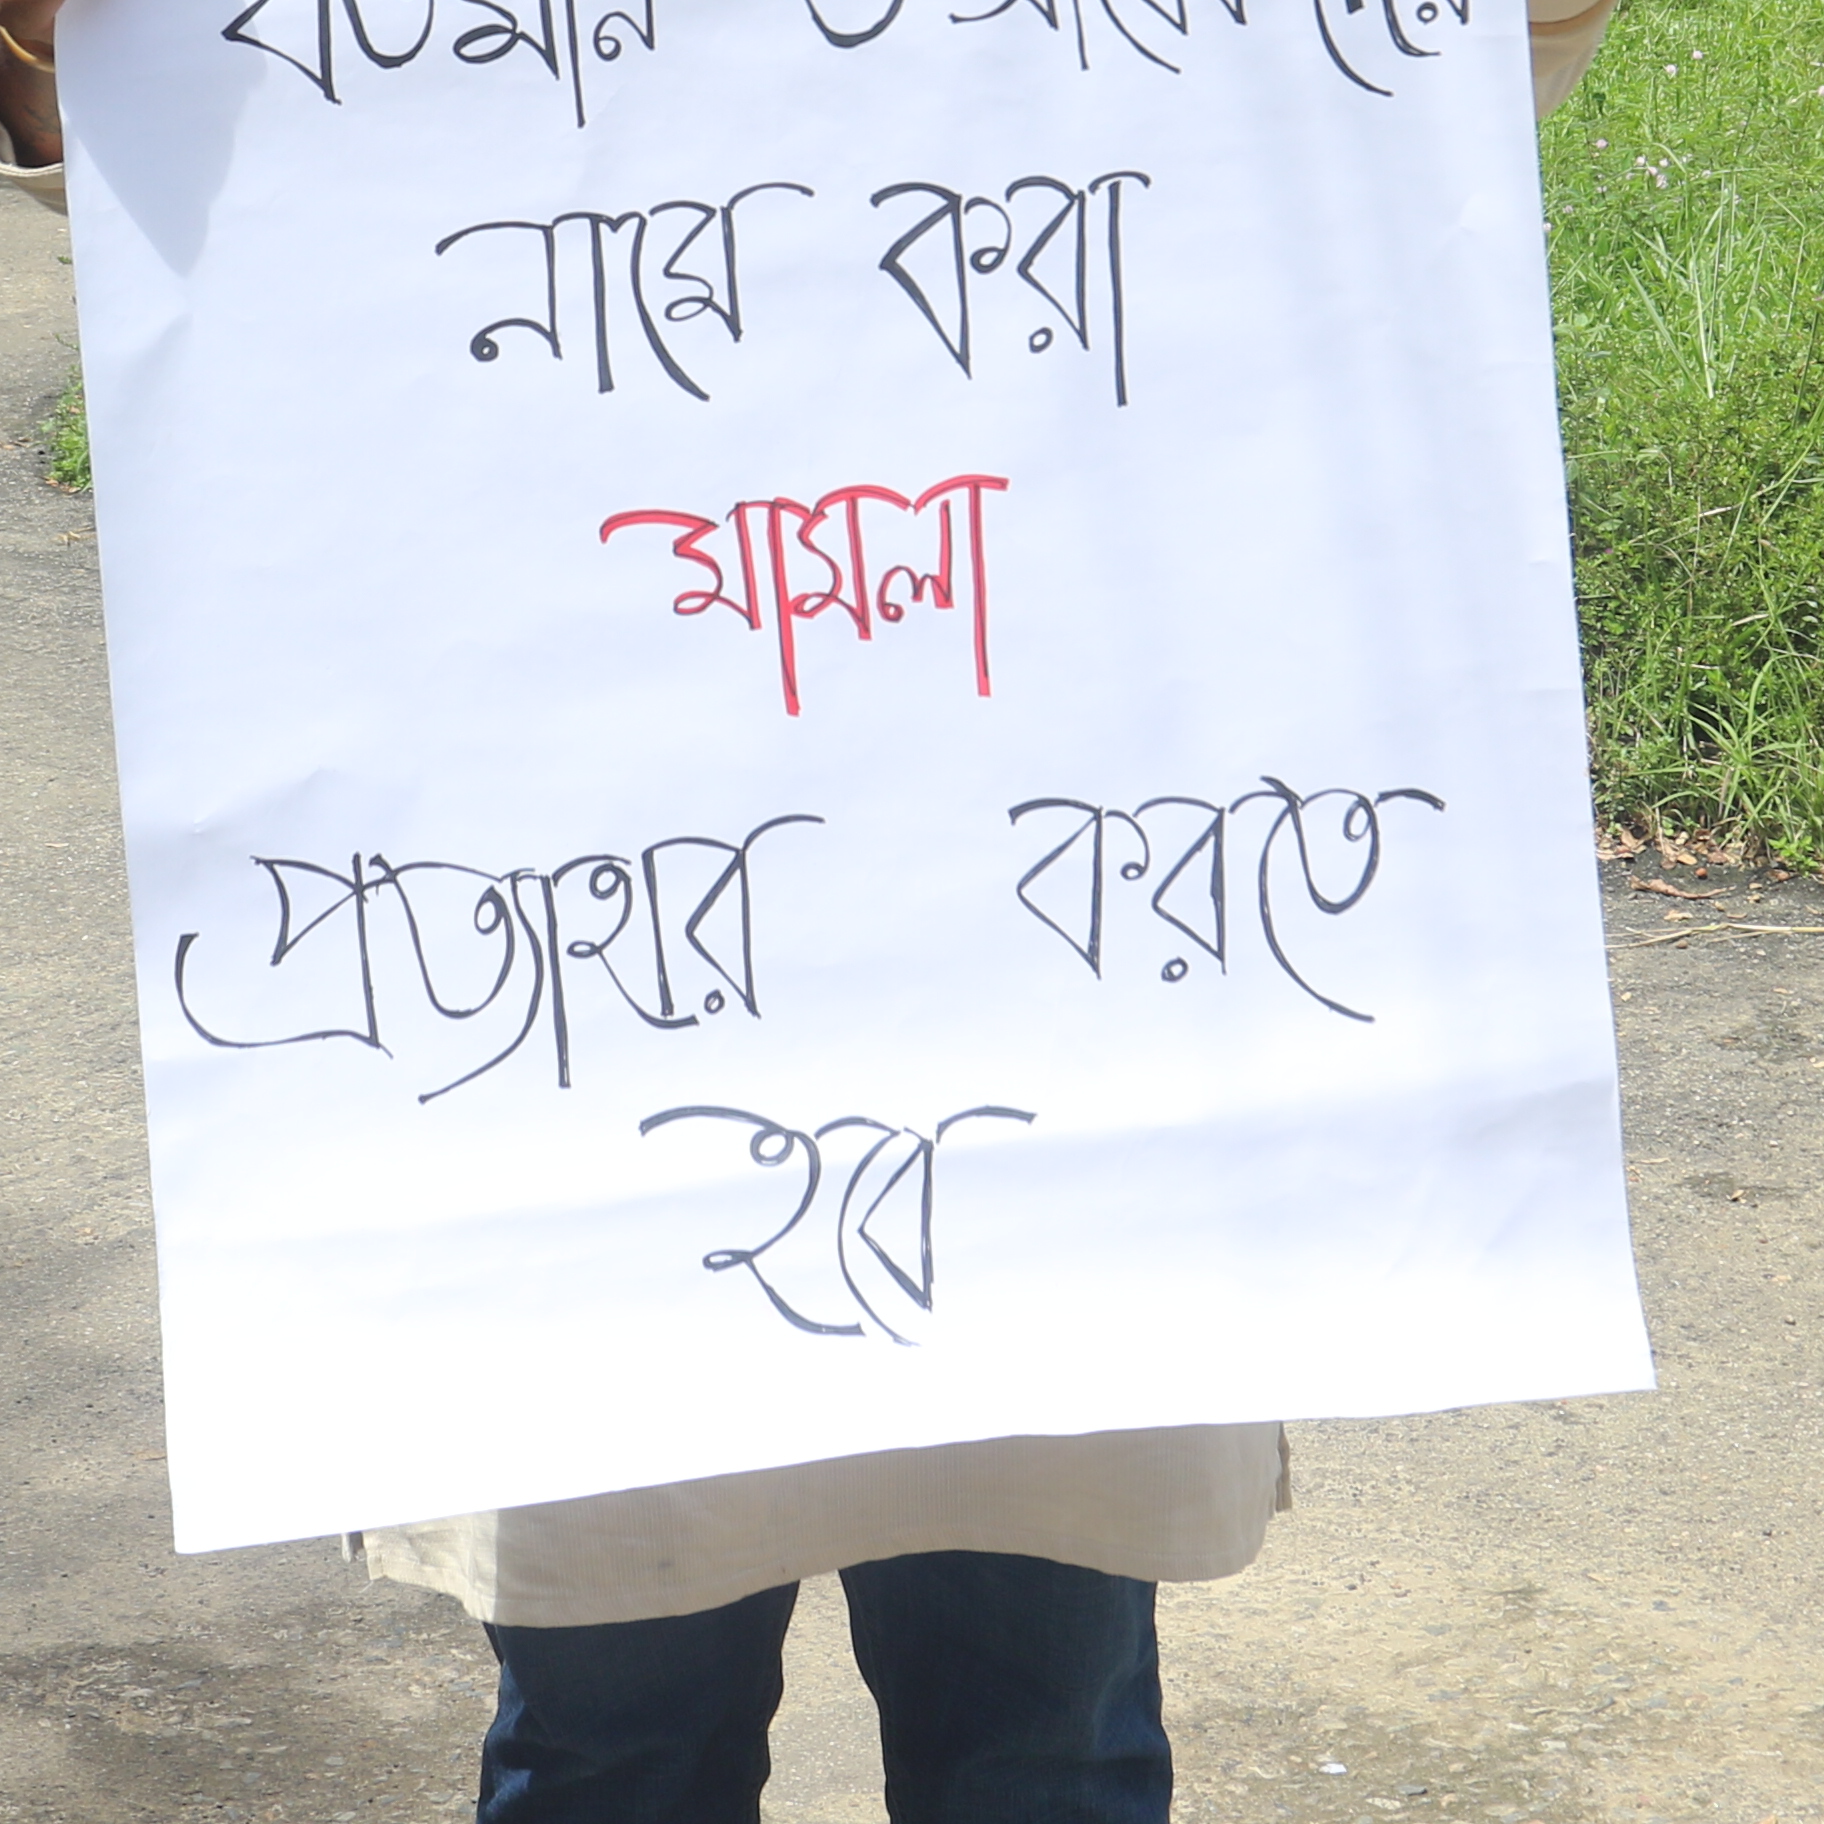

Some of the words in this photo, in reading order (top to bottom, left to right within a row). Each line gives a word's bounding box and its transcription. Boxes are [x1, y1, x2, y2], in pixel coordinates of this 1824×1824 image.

[434, 182, 815, 402] নামে
[869, 170, 1151, 407] করা
[600, 473, 1010, 718] মামলা
[175, 813, 826, 1104] প্রত্যাহার
[1008, 776, 1445, 1023] করতে
[638, 1103, 1037, 1346] হবে
